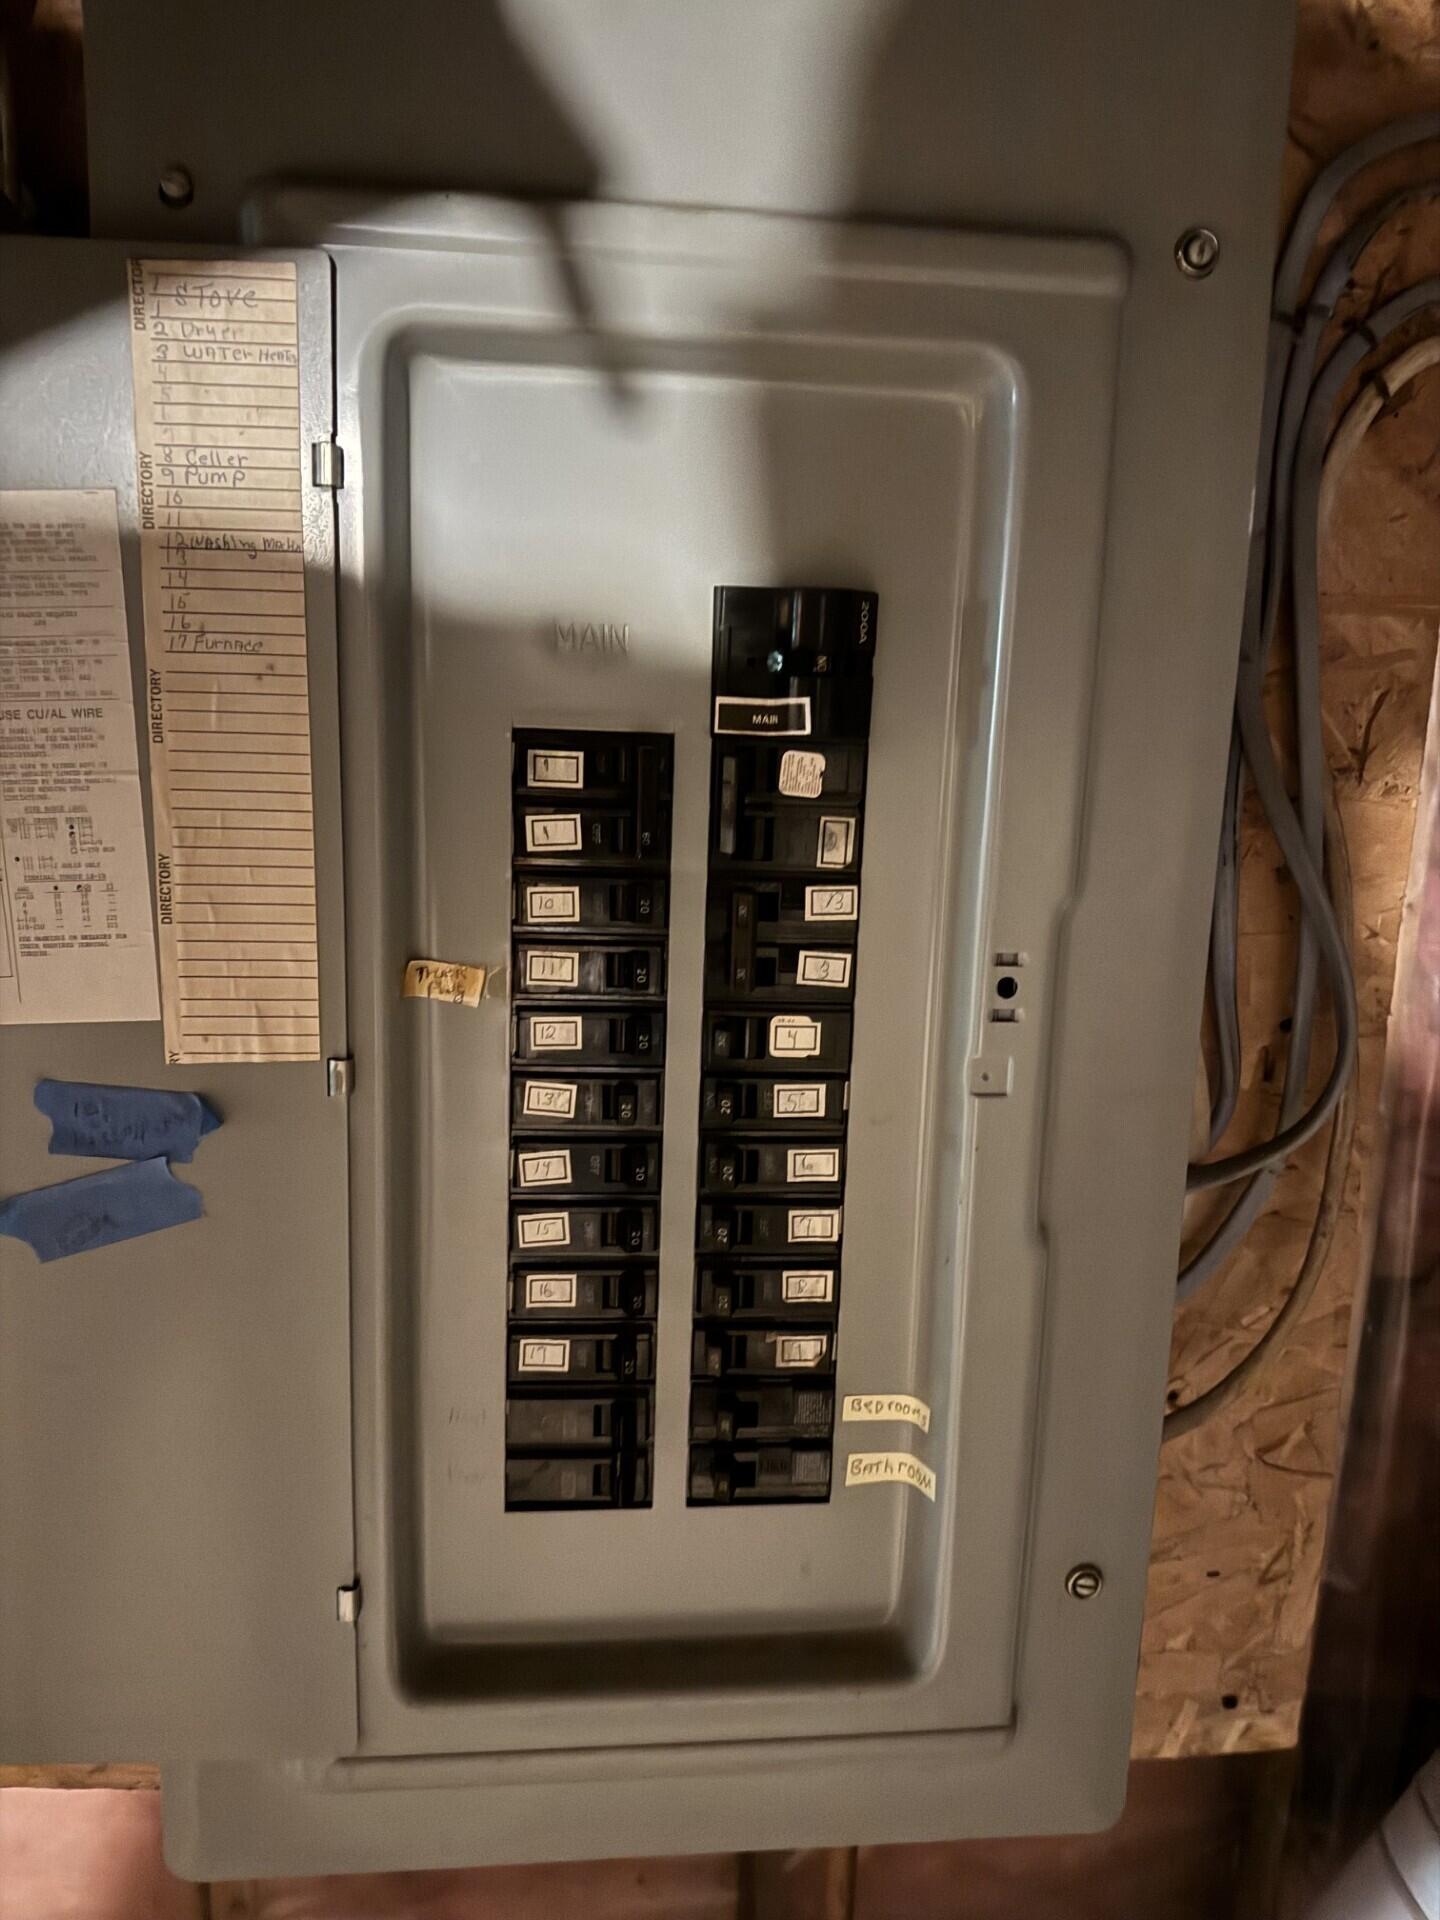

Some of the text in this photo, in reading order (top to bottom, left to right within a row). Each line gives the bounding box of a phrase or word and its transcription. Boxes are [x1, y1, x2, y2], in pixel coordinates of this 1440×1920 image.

[153, 321, 238, 341] 2 Dryer
[156, 344, 168, 360] 3
[186, 448, 248, 467] Celler
[161, 465, 246, 487] 9 Pump
[139, 451, 156, 530] DIRECTORY
[167, 511, 181, 527] 11
[168, 569, 188, 588] 14
[170, 614, 191, 630] 16
[859, 601, 870, 645] 200A
[169, 635, 187, 650] 17
[554, 623, 629, 655] MAIN
[27, 708, 66, 719] CU/AL
[71, 707, 103, 718] WIRE
[150, 668, 164, 744] DIRECTORY
[752, 714, 778, 725] MAIN
[158, 852, 173, 926] DIRECTORY
[538, 895, 554, 910] 10
[640, 899, 649, 914] 20
[636, 968, 647, 983] 20
[540, 1024, 556, 1041] 12
[787, 1030, 798, 1048] 4
[639, 1035, 648, 1049] 20
[621, 1103, 632, 1119] 20
[720, 1099, 731, 1115] 20
[534, 1161, 551, 1177] 14
[636, 1167, 645, 1181] 20
[722, 1166, 733, 1181] 20
[536, 1221, 557, 1236] 15
[717, 1228, 727, 1243] 20
[631, 1231, 641, 1245] 20
[539, 1282, 553, 1298] 16
[530, 1346, 546, 1363] 17
